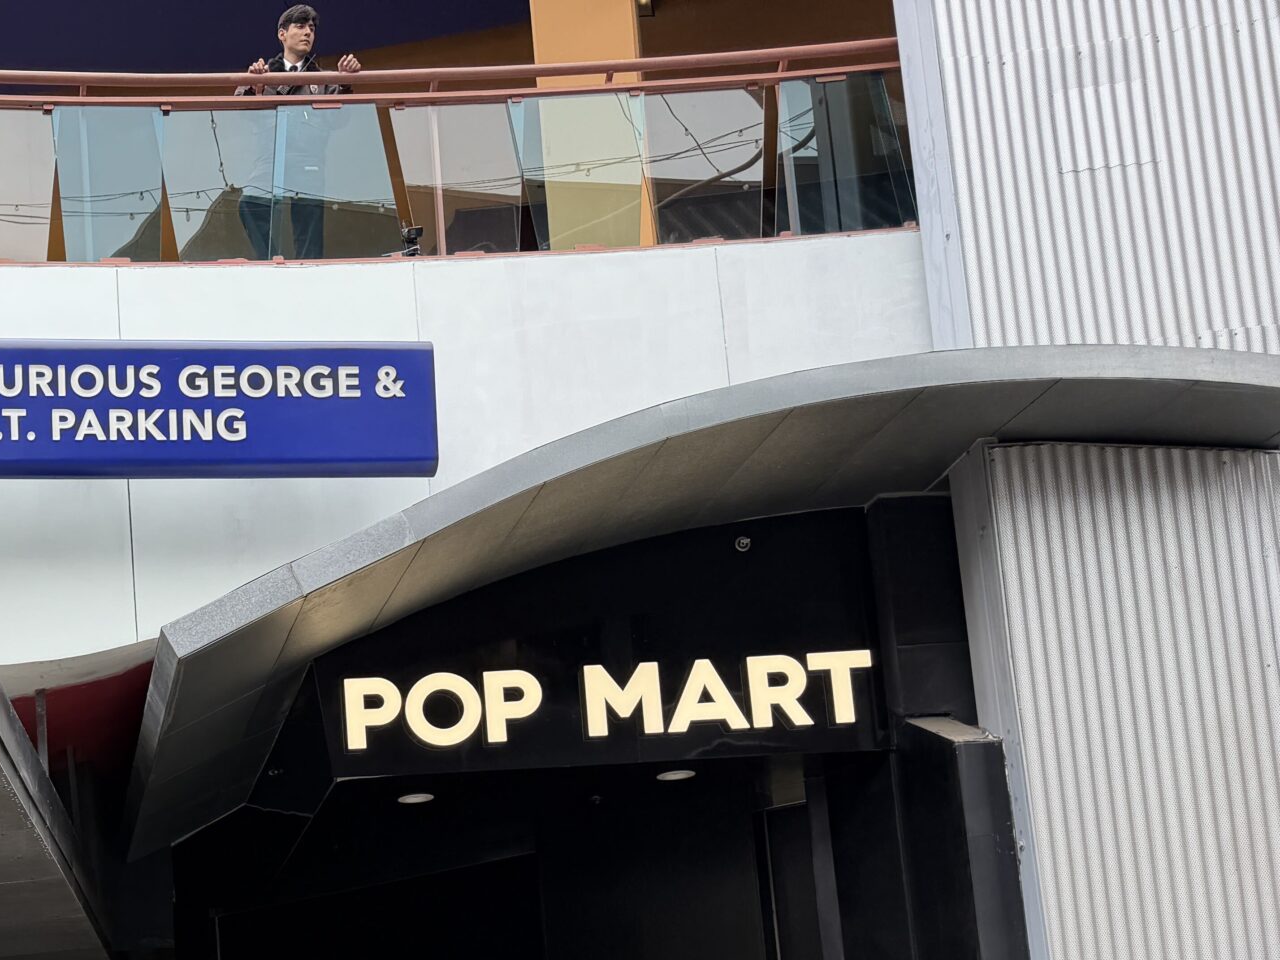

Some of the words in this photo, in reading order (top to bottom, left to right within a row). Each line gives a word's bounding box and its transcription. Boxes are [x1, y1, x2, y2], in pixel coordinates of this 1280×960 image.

[177, 364, 362, 400] GEORGE
[374, 366, 406, 400] &
[51, 409, 249, 443] PARKING
[343, 669, 543, 750] POP
[583, 650, 872, 737] MART
